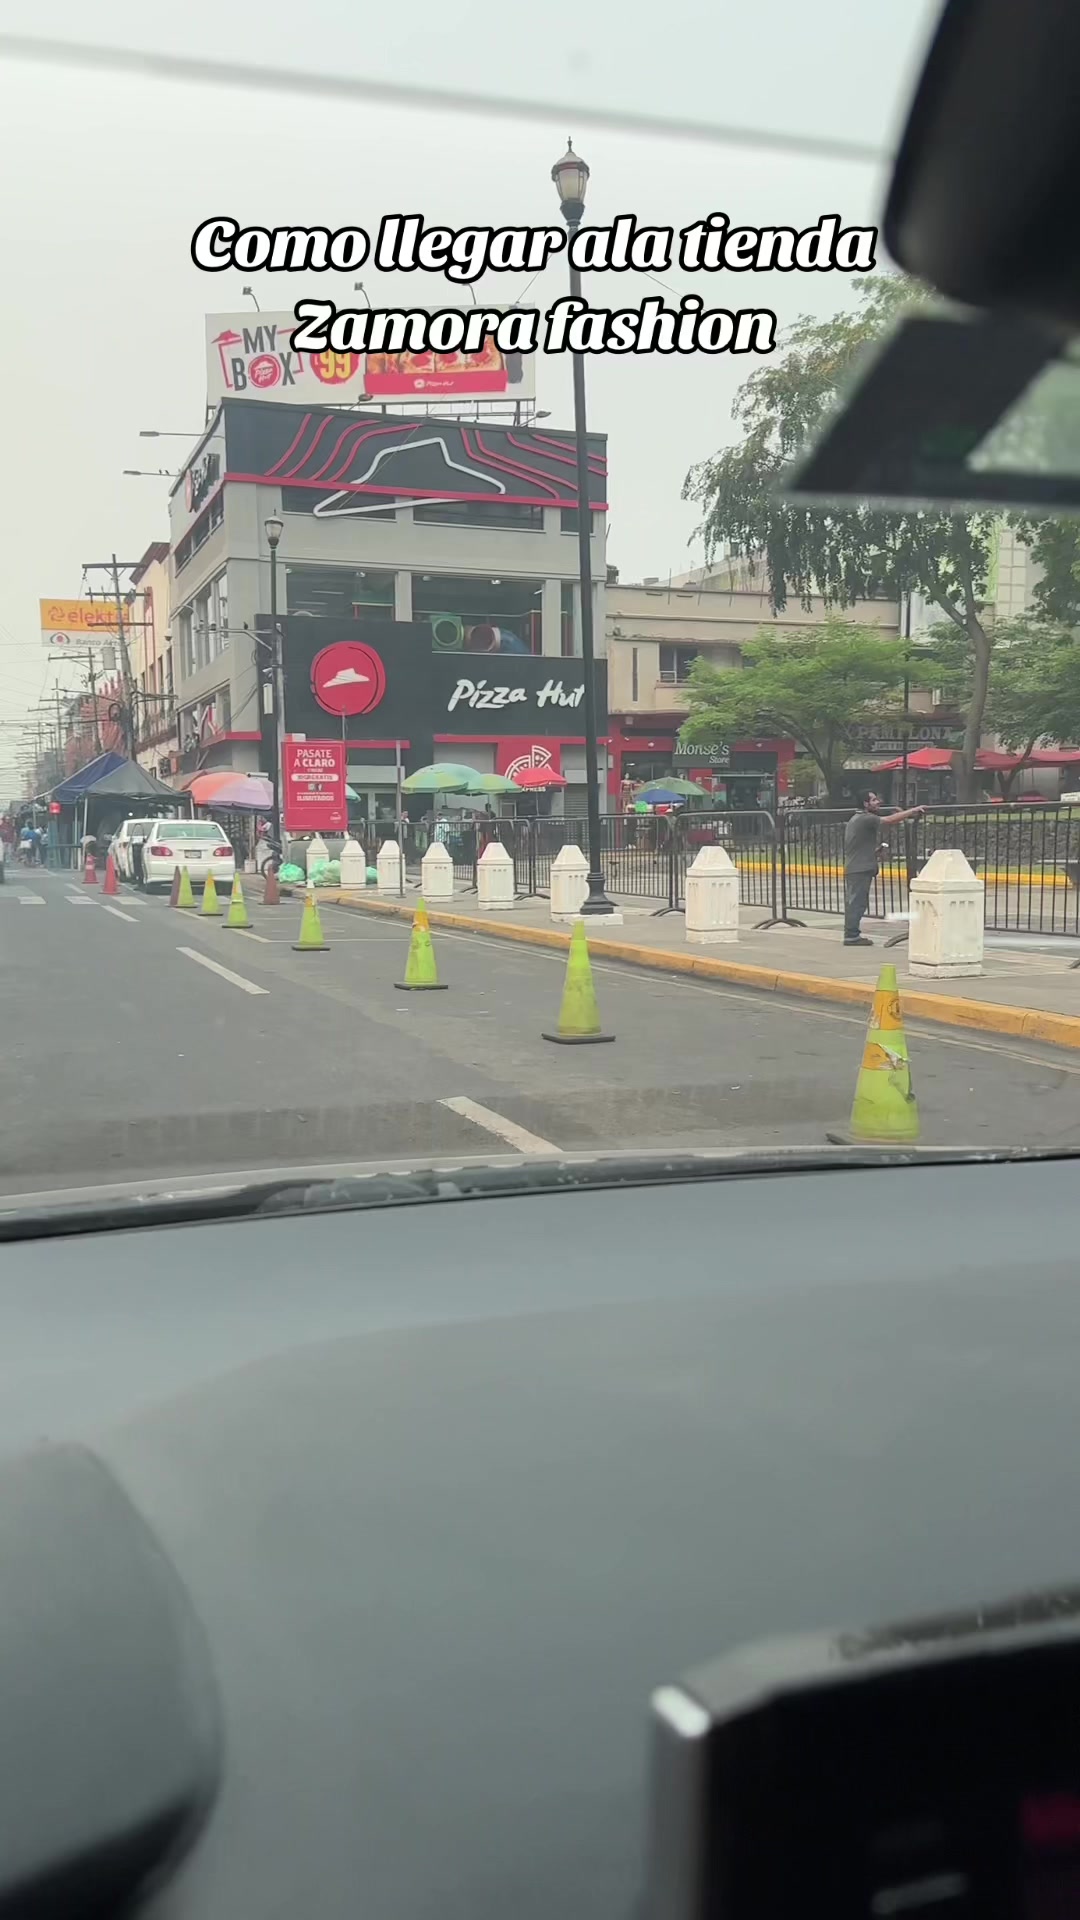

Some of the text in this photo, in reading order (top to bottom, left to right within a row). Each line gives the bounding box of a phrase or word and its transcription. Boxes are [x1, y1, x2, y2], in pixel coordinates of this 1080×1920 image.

[242, 325, 277, 354] MY
[447, 679, 585, 712] Pizza Hut
[296, 749, 332, 758] PASATE
[674, 741, 730, 755] Monse's
[293, 758, 336, 768] A CLARO
[709, 756, 730, 764] Store
